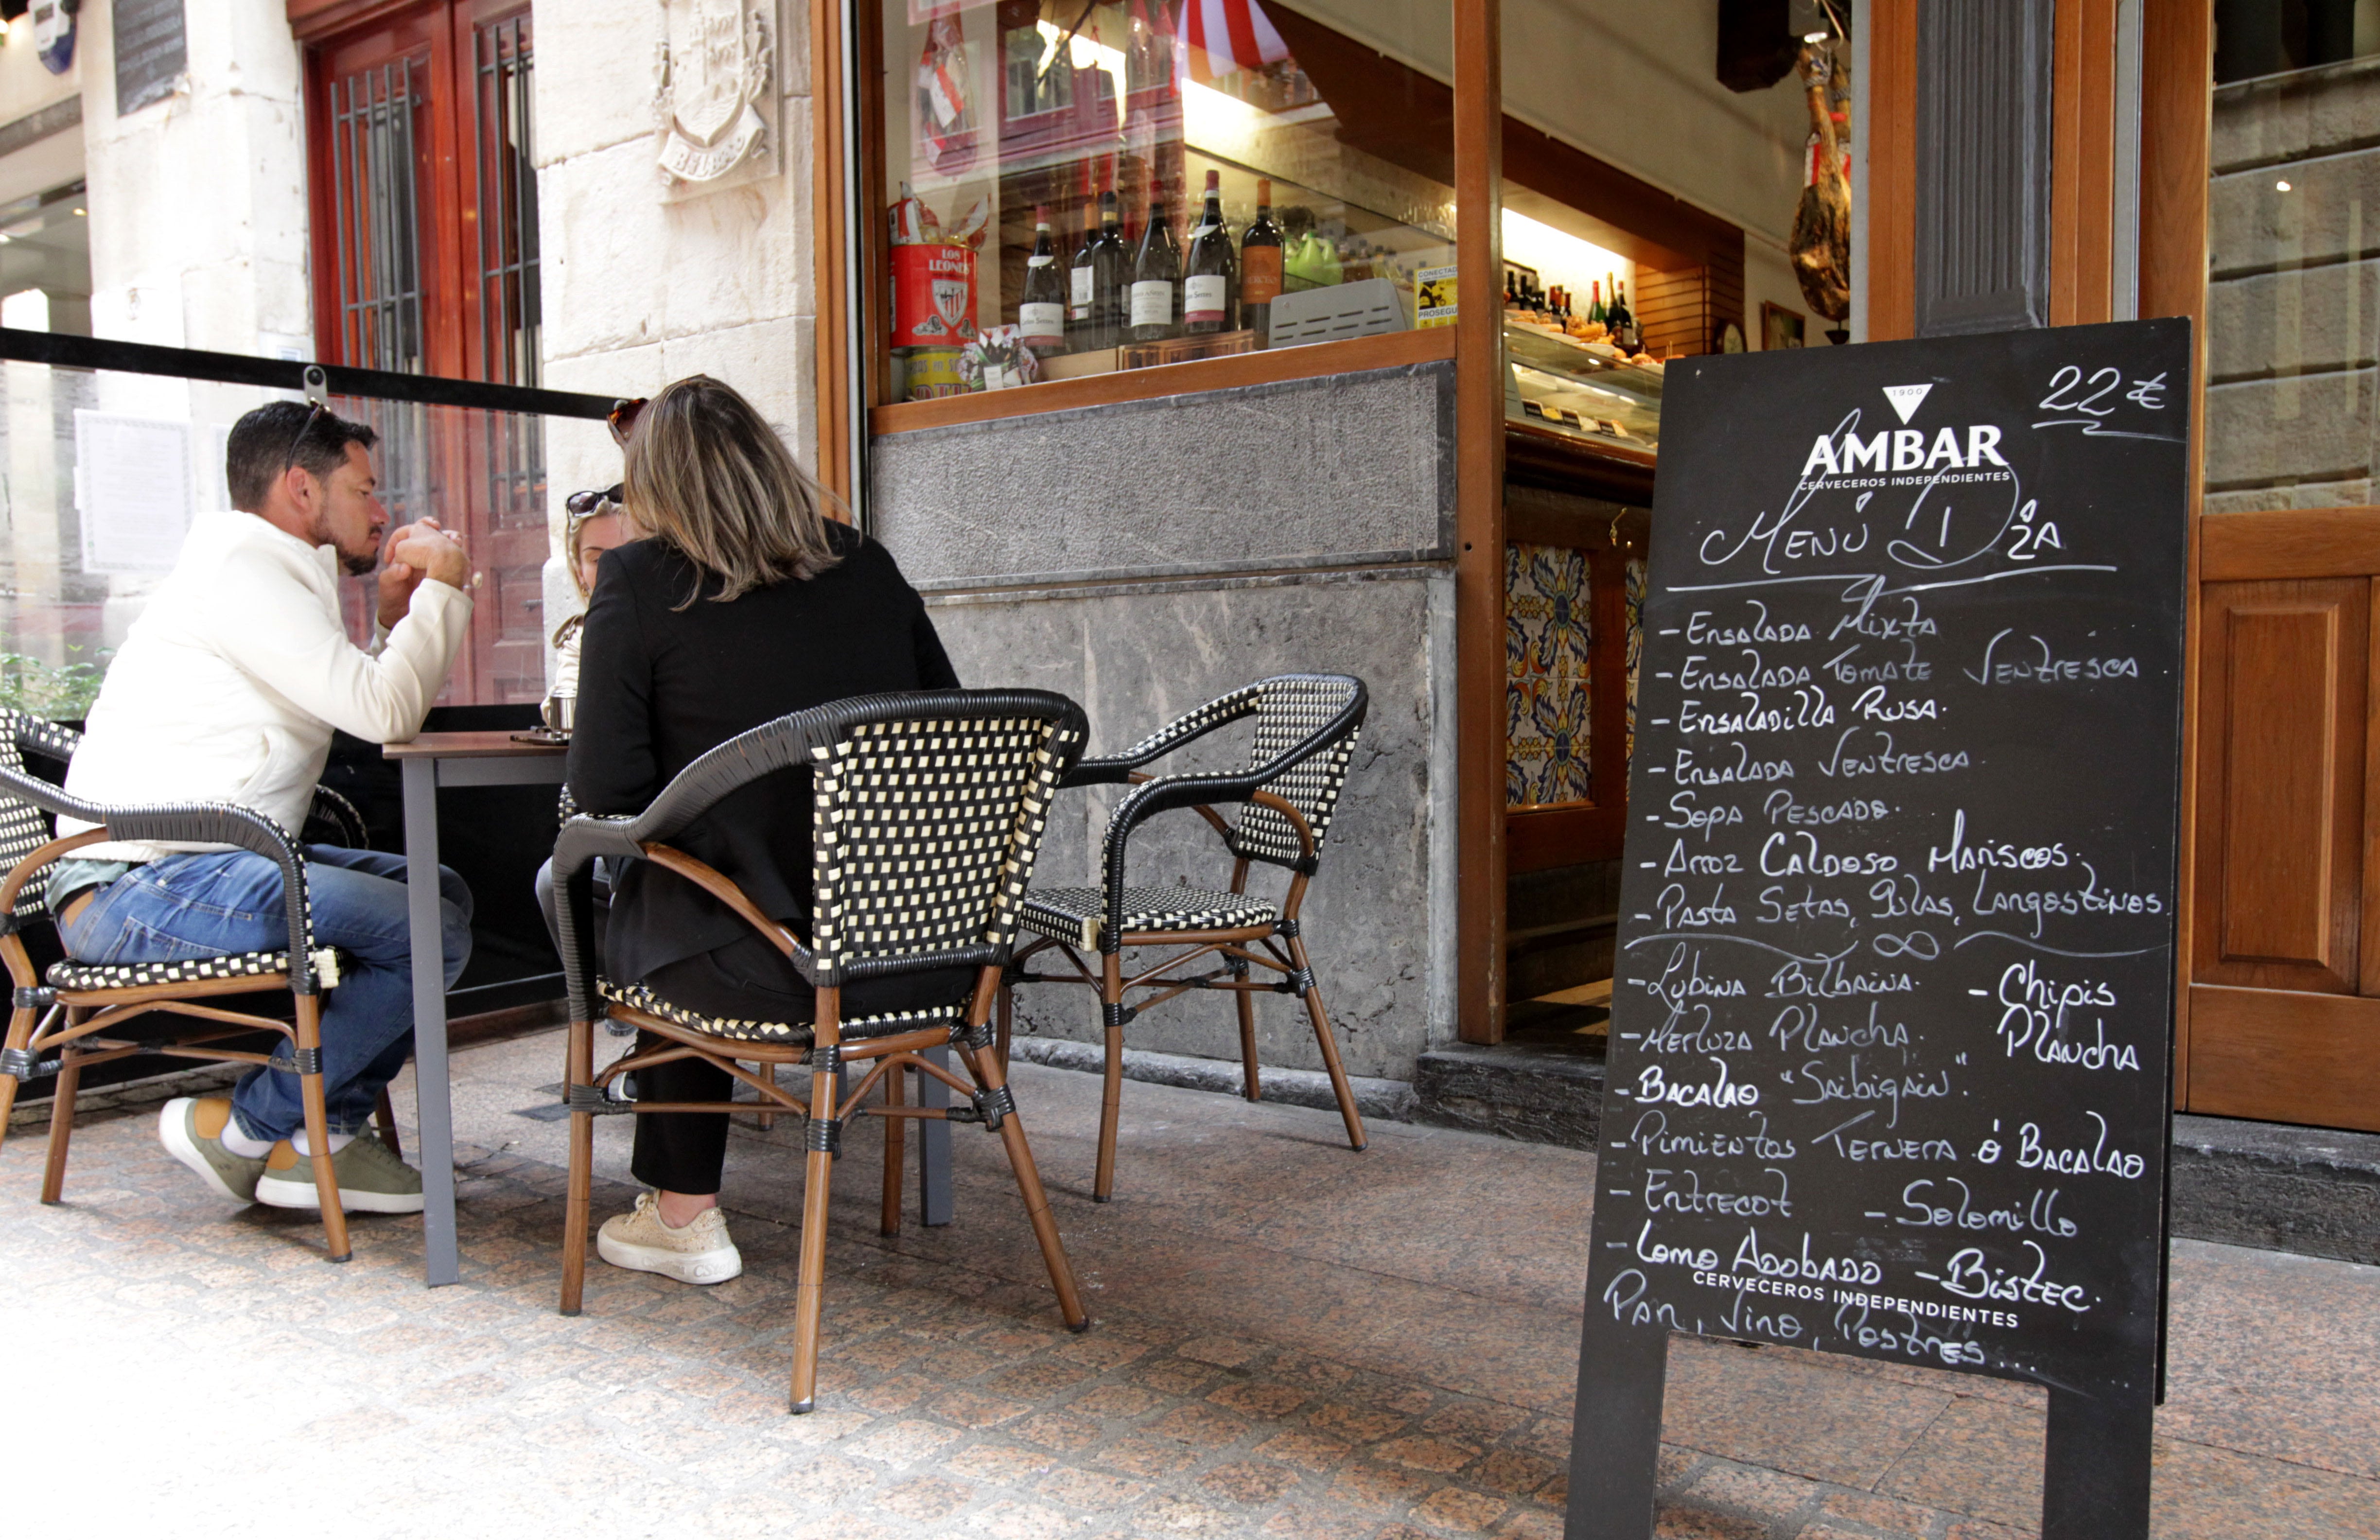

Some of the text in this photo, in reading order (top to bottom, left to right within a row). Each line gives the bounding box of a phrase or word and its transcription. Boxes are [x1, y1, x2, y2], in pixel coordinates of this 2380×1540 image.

[942, 248, 960, 260] LOS
[1892, 388, 1923, 396] 1900
[1801, 424, 2010, 476] AMBAR
[1799, 472, 2011, 490] CERVECEROS INDEPENDIENTES
[1692, 1271, 2019, 1329] CERVECEROS INDEPENDIENTES
